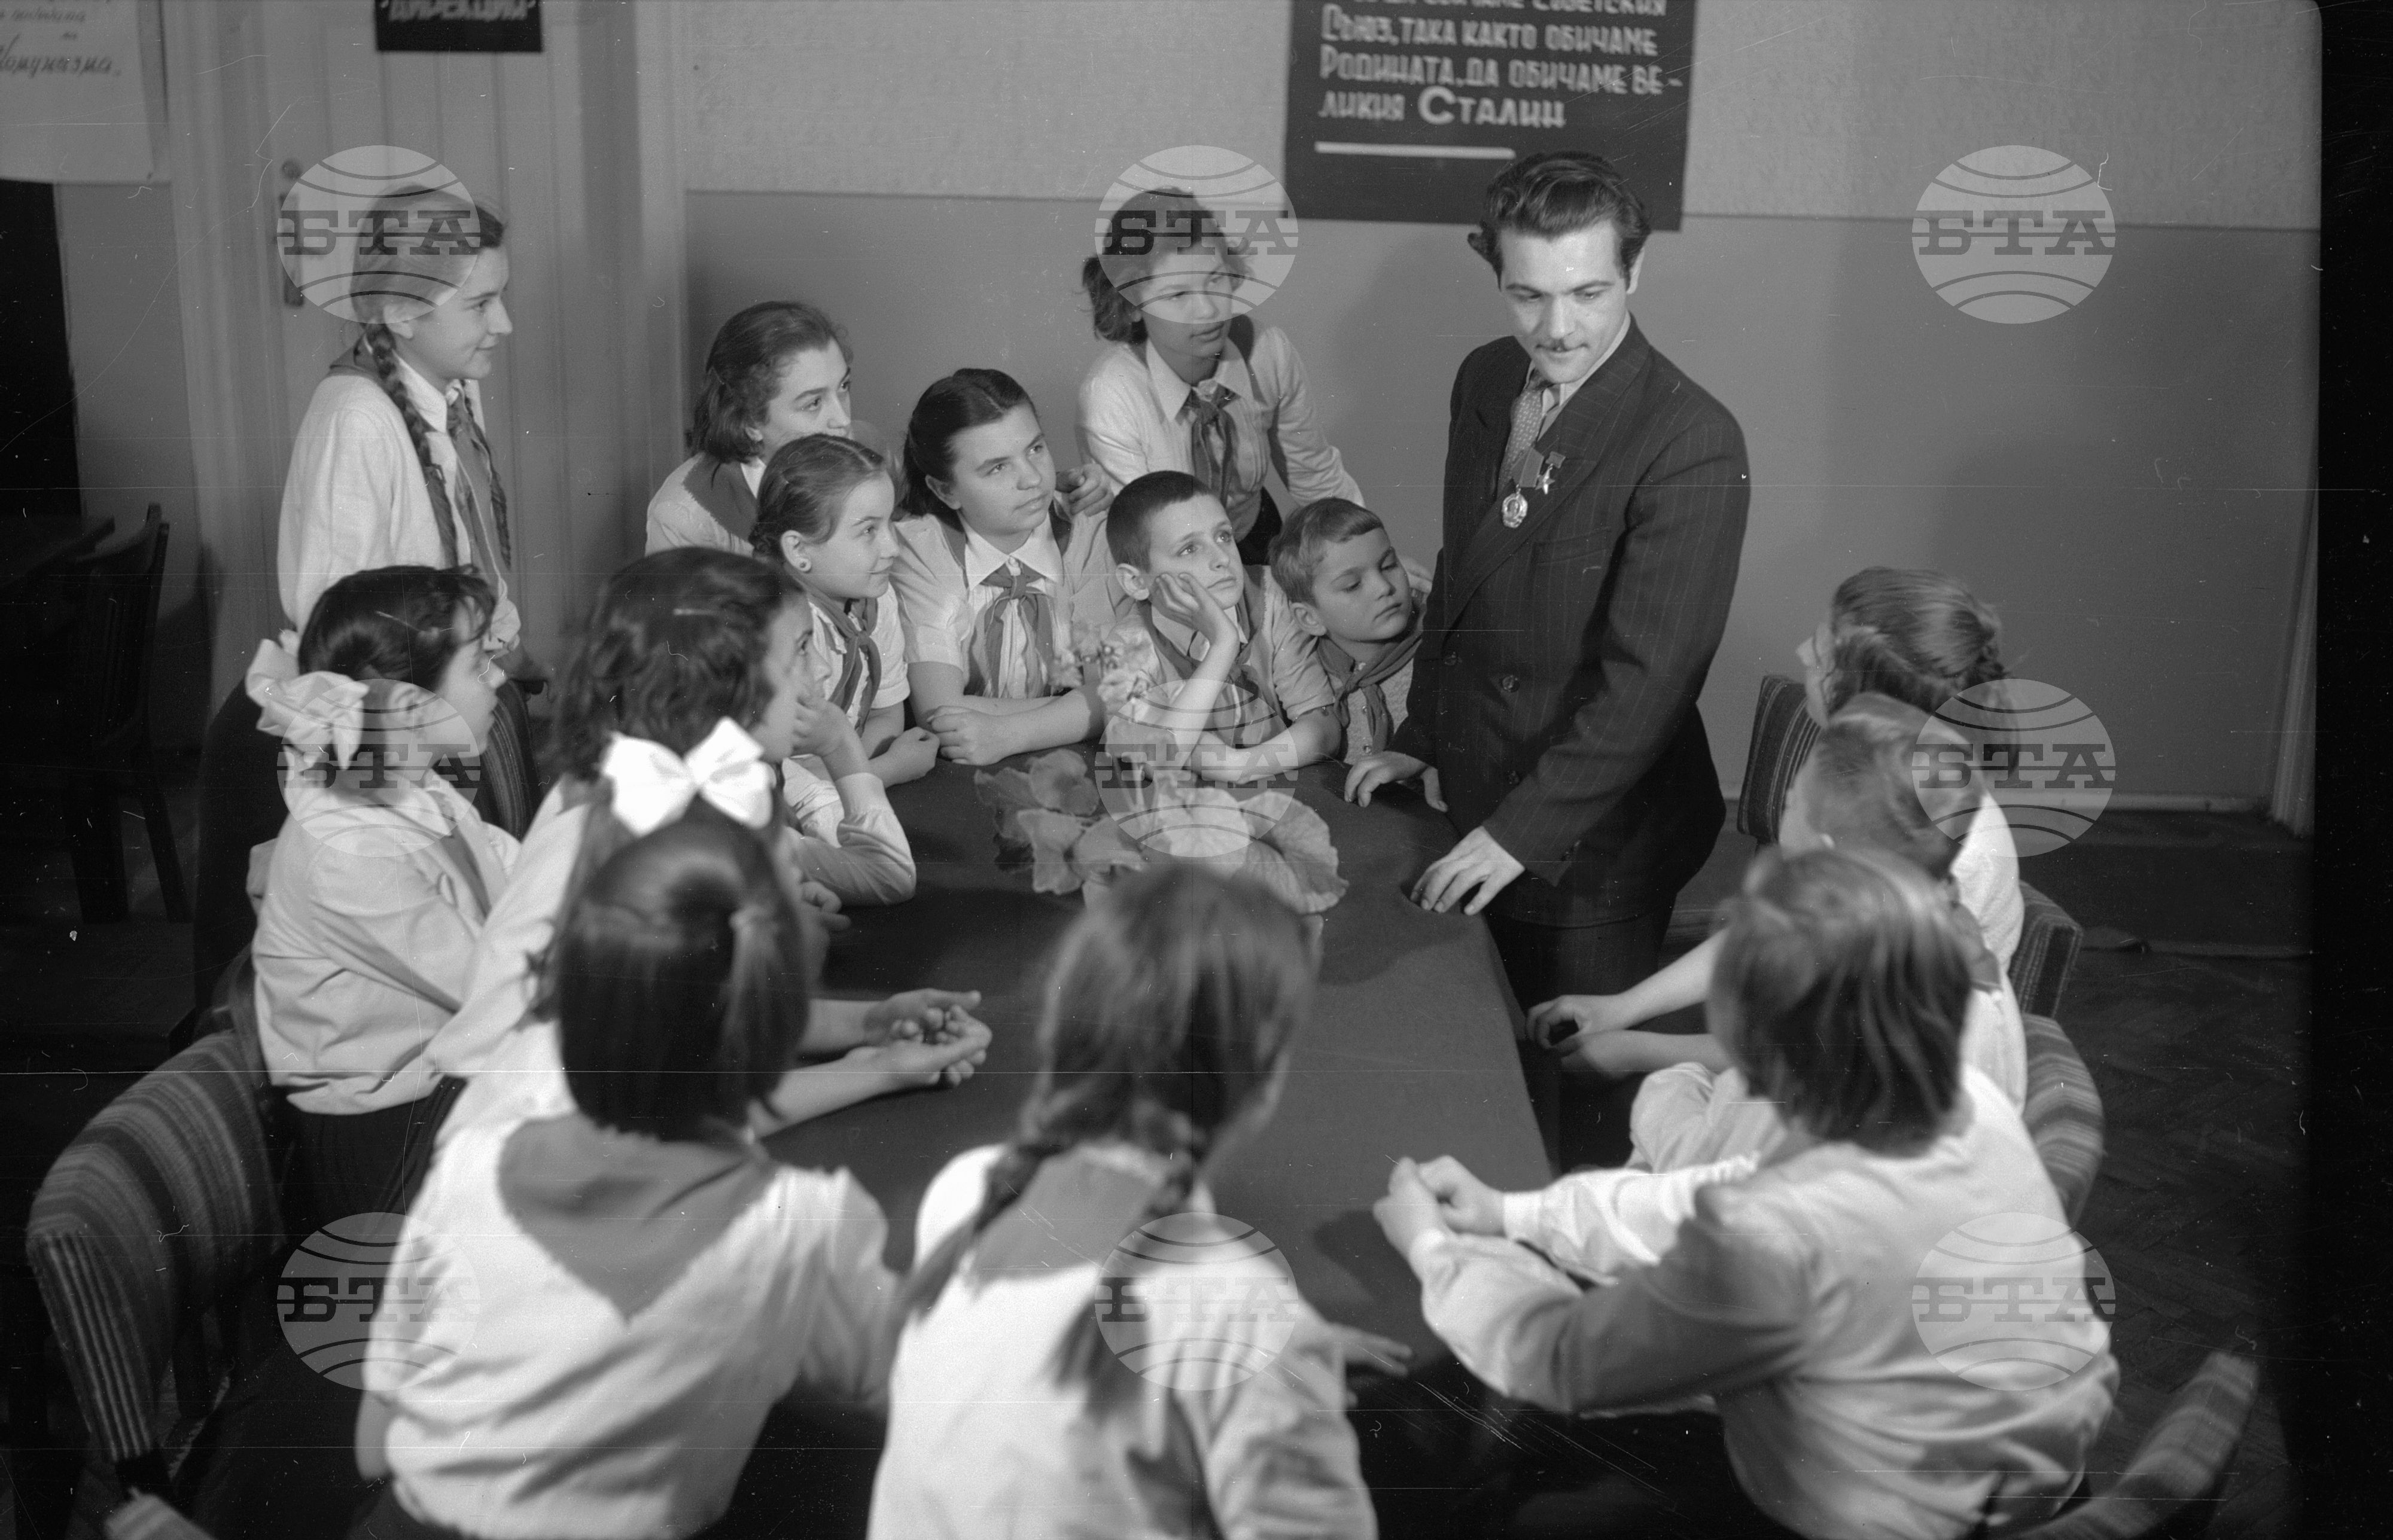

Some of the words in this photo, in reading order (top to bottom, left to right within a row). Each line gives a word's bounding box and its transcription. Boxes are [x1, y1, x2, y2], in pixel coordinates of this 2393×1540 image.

[1461, 20, 1538, 50] КАКТО
[1544, 24, 1658, 57] ОБИЧАМЕ
[1465, 57, 1500, 88] ДА
[1508, 59, 1628, 94] ОБИЧАМЕ
[1318, 90, 1406, 121] ЛИКИЯ
